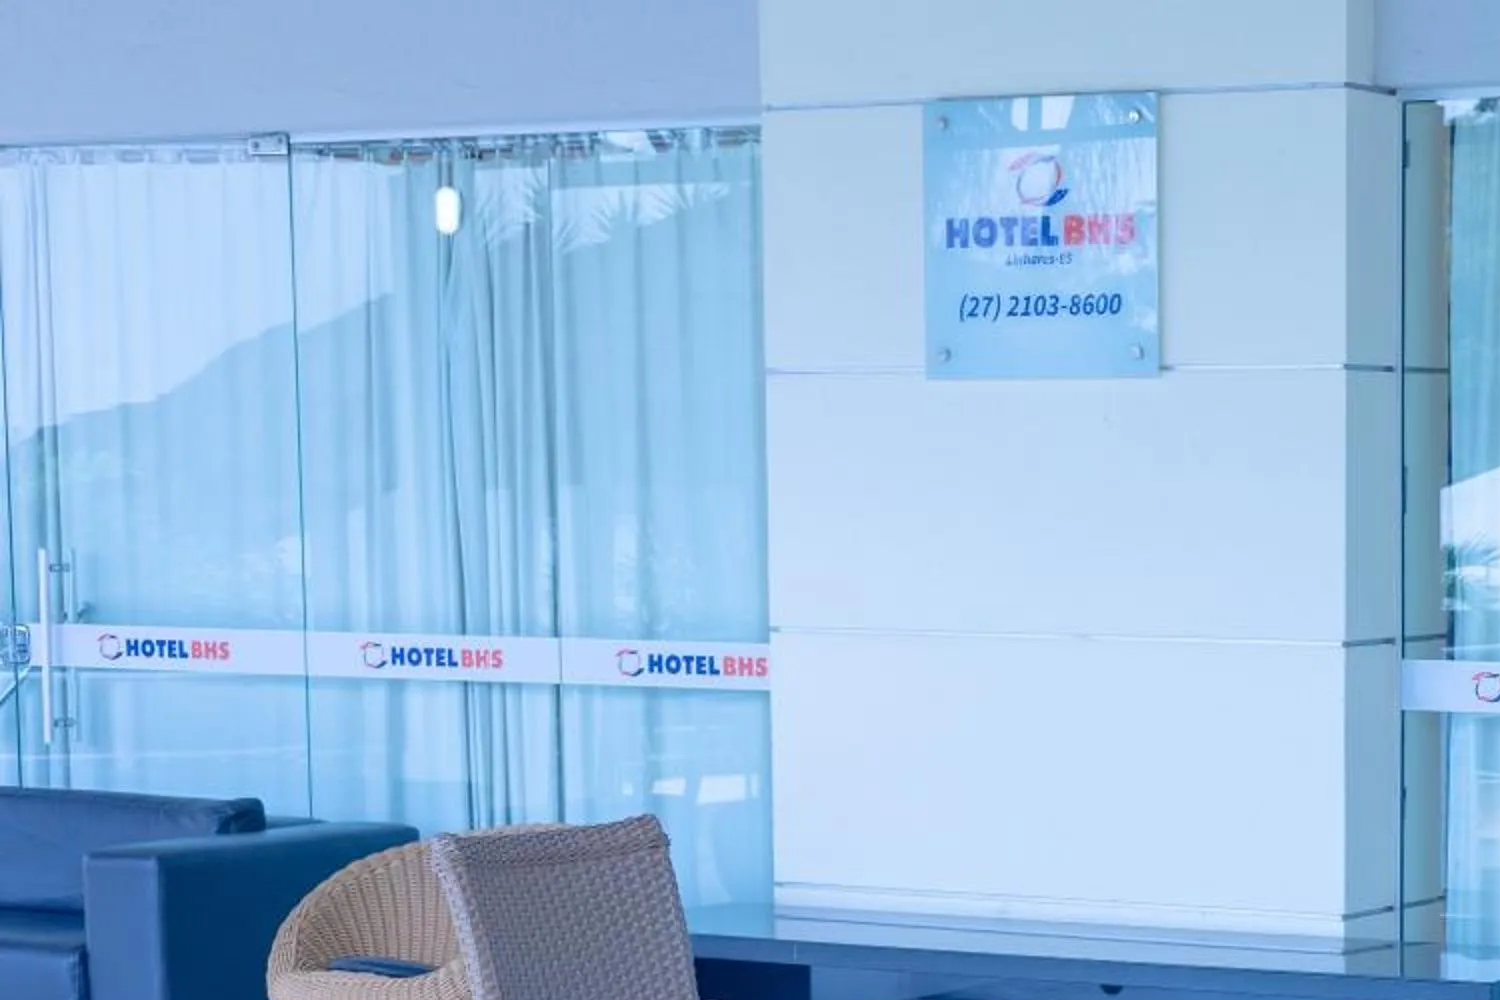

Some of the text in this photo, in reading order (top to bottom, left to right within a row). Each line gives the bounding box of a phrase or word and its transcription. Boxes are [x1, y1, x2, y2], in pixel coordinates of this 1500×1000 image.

[945, 214, 1136, 249] HOTEL BHS
[959, 293, 1123, 322] (27) 2103-8600
[125, 639, 231, 661] HOTEL BHS
[391, 646, 504, 669] HOTEL BHS
[647, 653, 768, 677] HOTEL BHS
